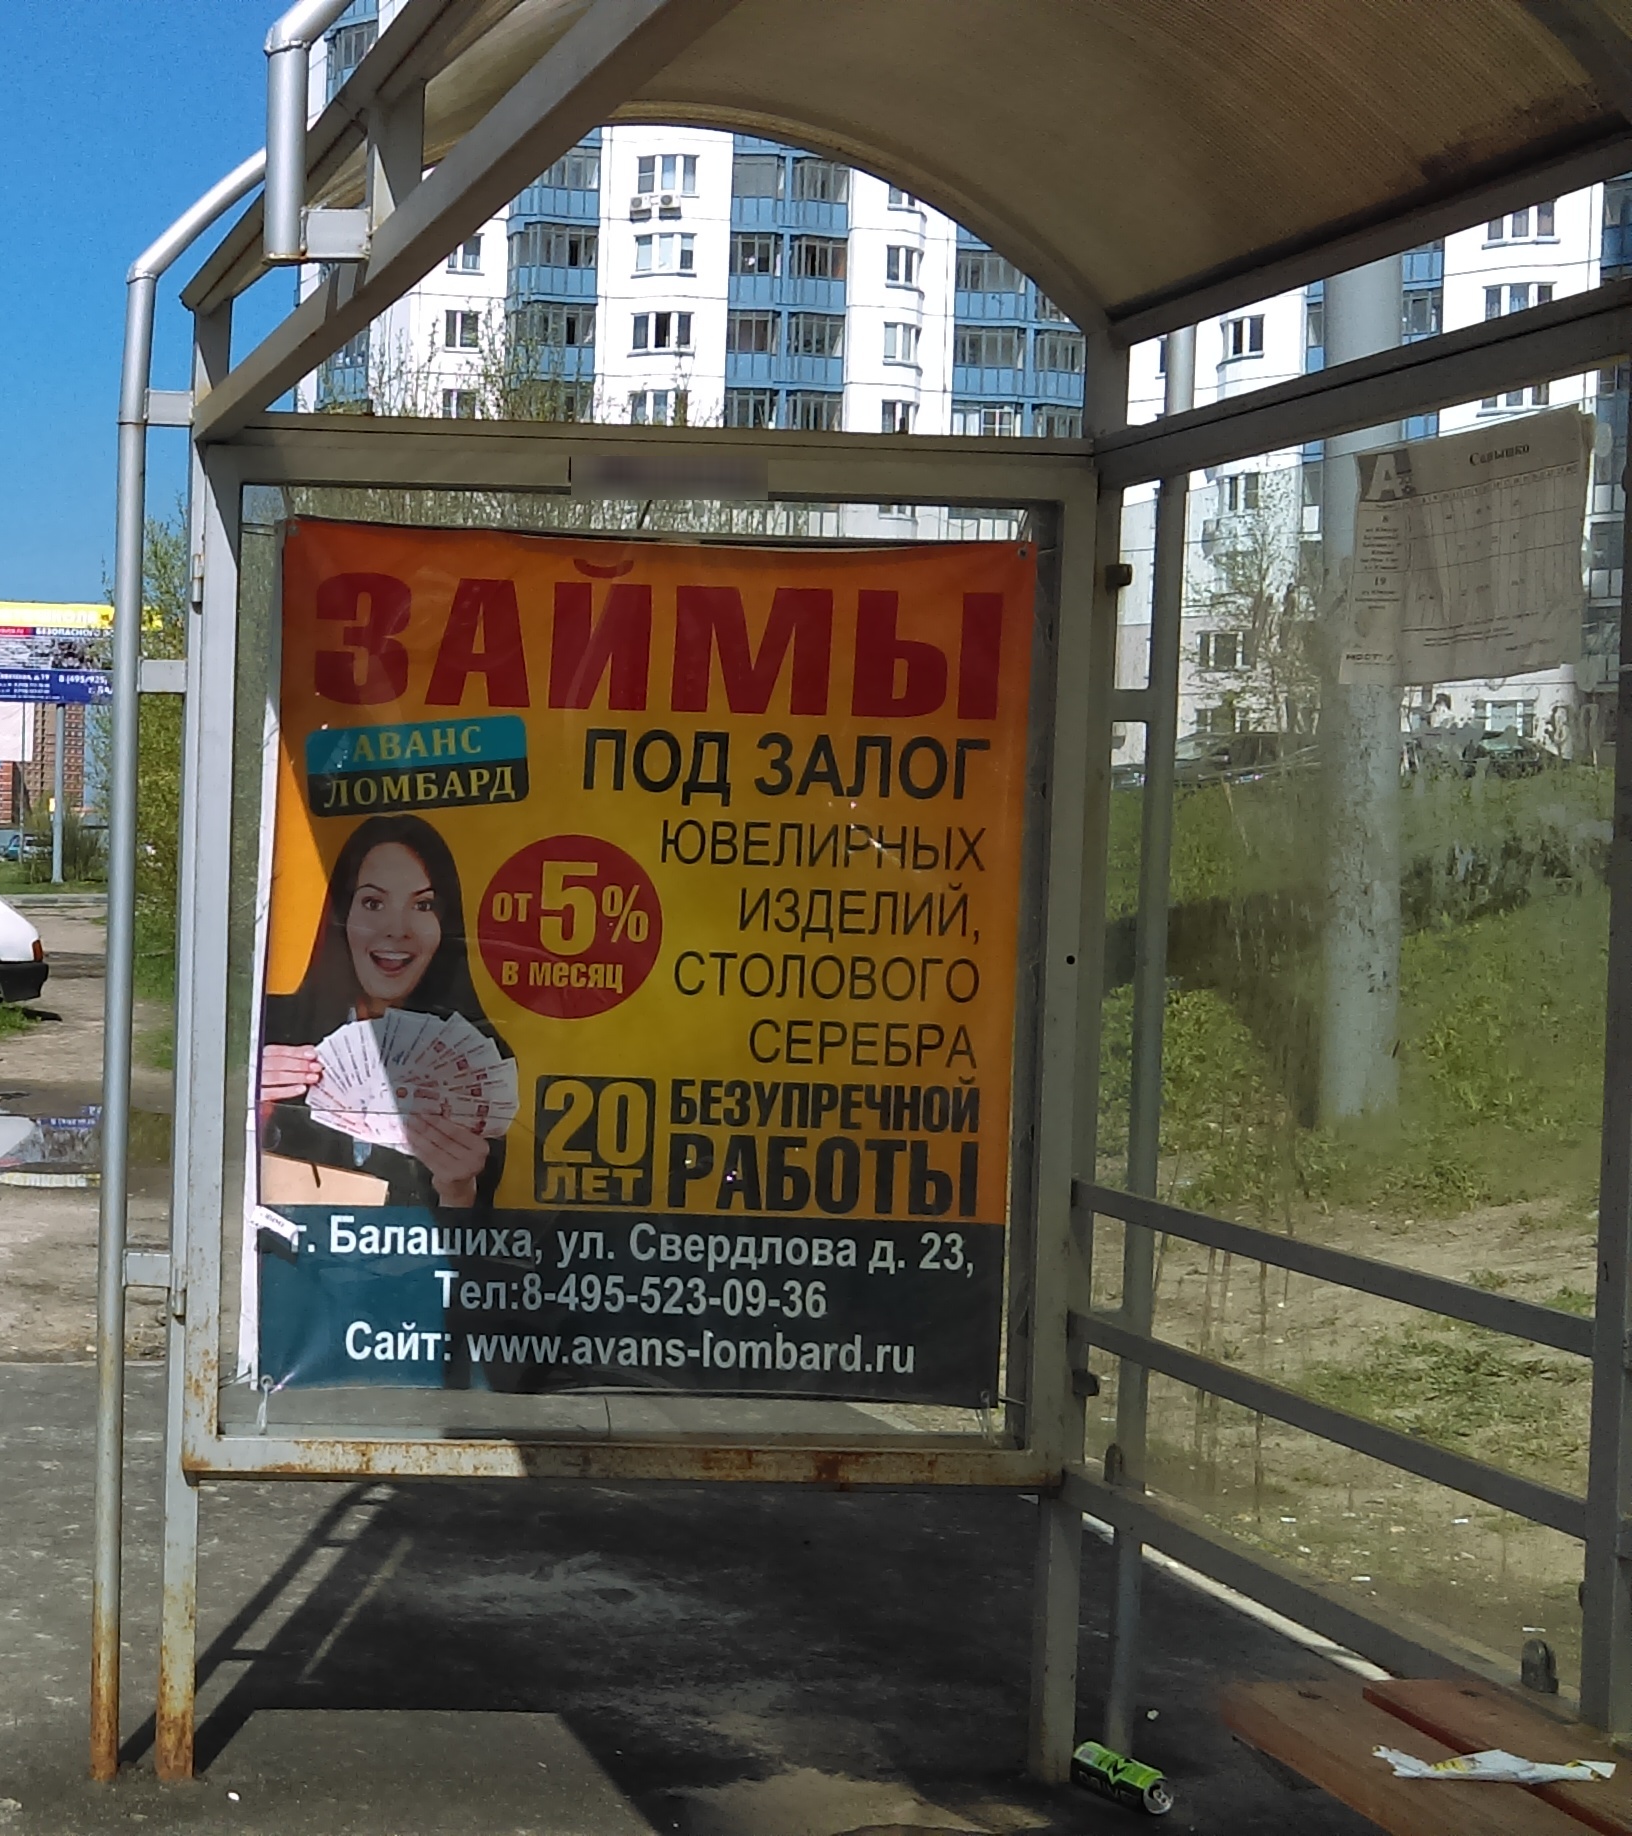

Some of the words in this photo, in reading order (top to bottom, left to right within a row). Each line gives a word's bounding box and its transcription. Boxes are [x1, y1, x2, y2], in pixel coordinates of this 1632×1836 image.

[314, 557, 1005, 720] ЗАЙМЫ
[352, 725, 483, 763] АВАНС
[582, 727, 732, 806] ПОД
[753, 732, 991, 800] ЗАЛОГ
[323, 766, 517, 808] ЛОМБАРД
[660, 818, 988, 872] ЮВЕЛИРНЫХ
[491, 888, 531, 923] от
[537, 861, 650, 957] 5%
[737, 882, 982, 944] ИЗДЕЛИЙ,
[501, 961, 518, 987] в
[528, 962, 624, 994] месяц
[673, 951, 981, 1004] СТОЛОВОГО
[747, 1018, 977, 1069] СЕРЕБРА
[543, 1078, 647, 1168] 20
[669, 1076, 979, 1134] БЕЗУПРЕЧНОЙ
[545, 1165, 644, 1205] ЛЕТ
[667, 1133, 978, 1218] РАБОТЫ
[330, 1214, 543, 1265] Балашиха,
[557, 1229, 615, 1266] ул.
[629, 1223, 859, 1272] Свердлова
[868, 1239, 906, 1275] д.
[920, 1230, 976, 1279] 23,
[434, 1269, 828, 1318] Тел:8-495-523-09-36
[344, 1322, 453, 1363] Сайт:
[467, 1328, 916, 1375] www.avans-lombard.ru
